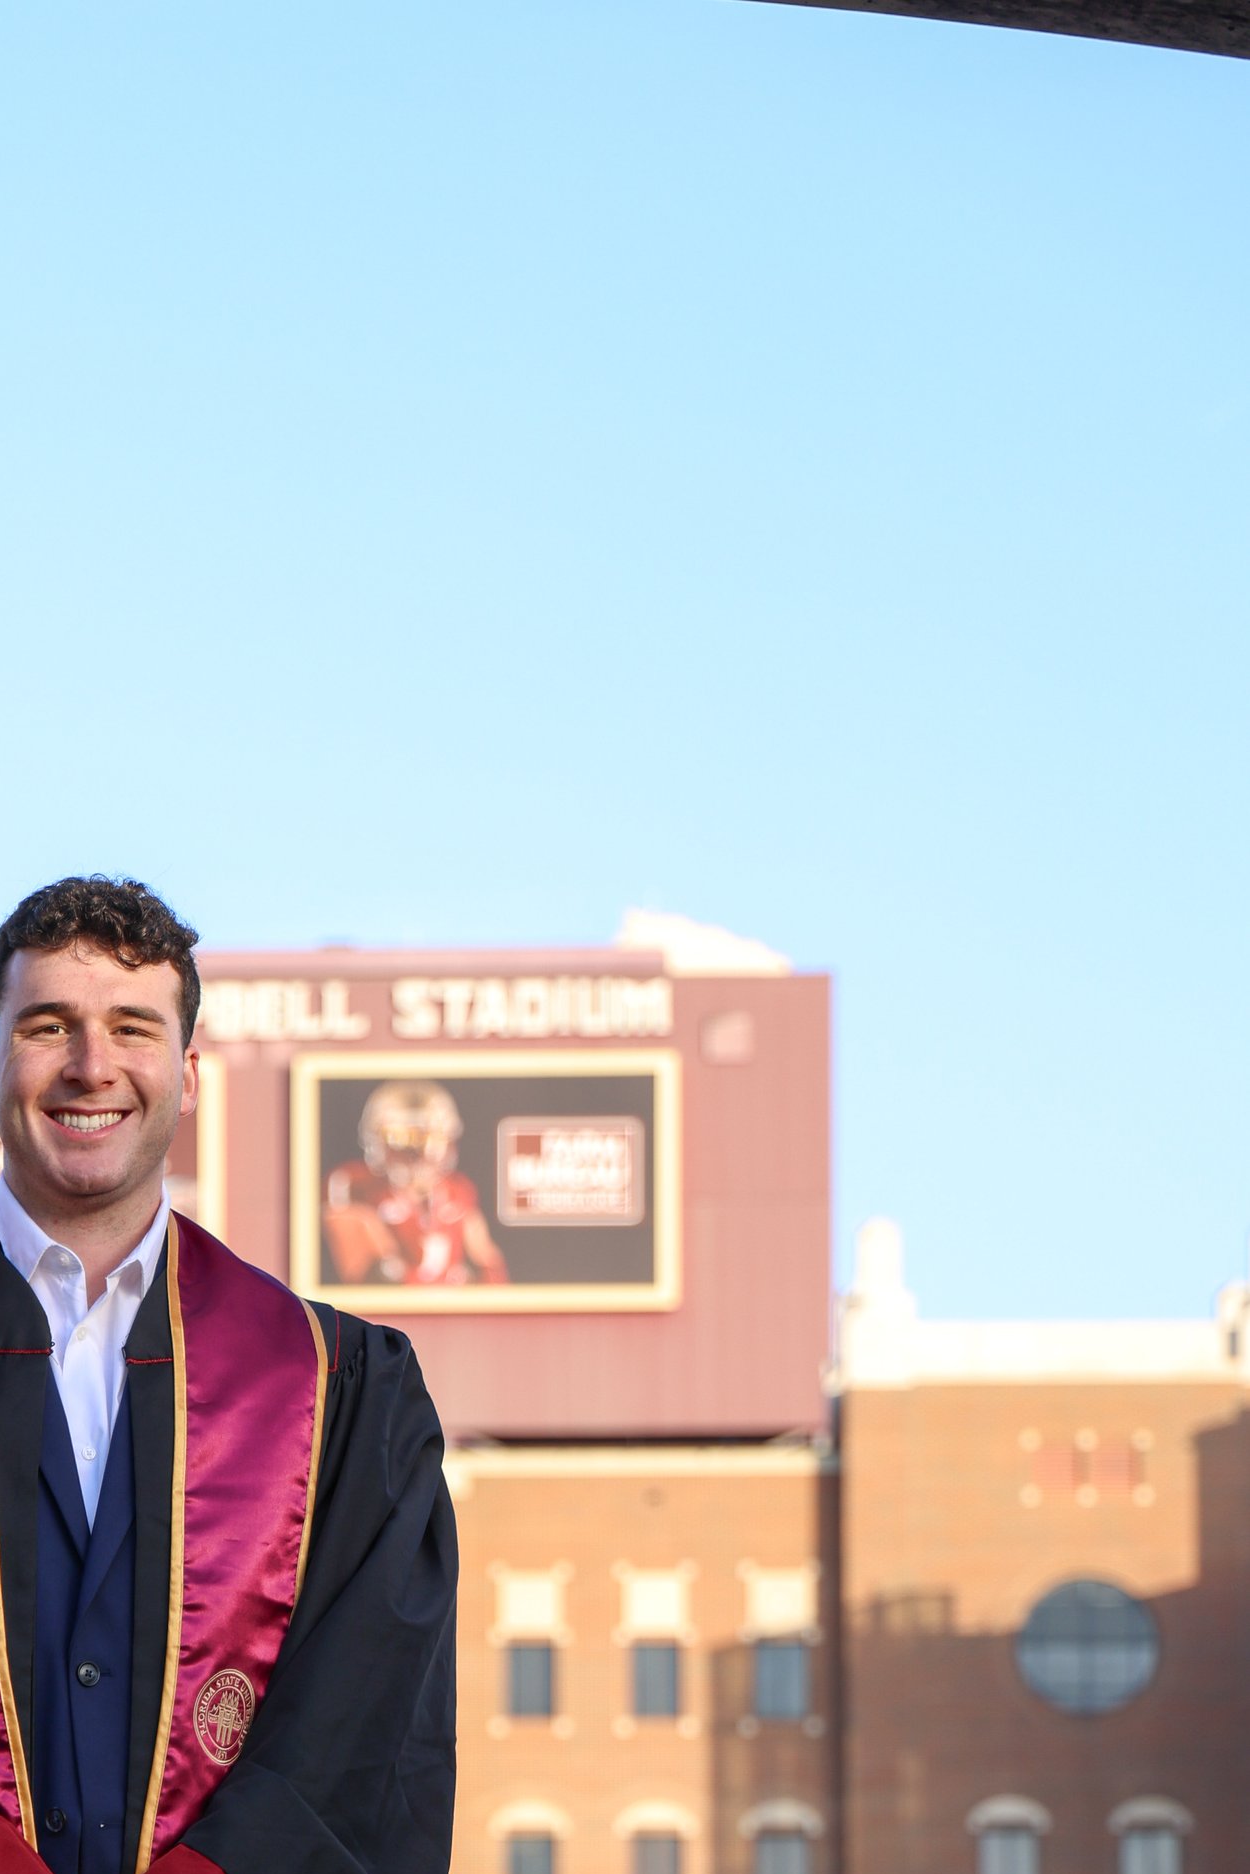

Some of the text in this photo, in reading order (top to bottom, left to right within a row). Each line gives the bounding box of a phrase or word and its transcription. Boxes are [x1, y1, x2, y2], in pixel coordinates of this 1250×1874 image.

[200, 979, 371, 1041] BELL
[390, 976, 674, 1038] STADIUM
[198, 1687, 216, 1736] FLORIDA
[216, 1676, 240, 1688] STATE
